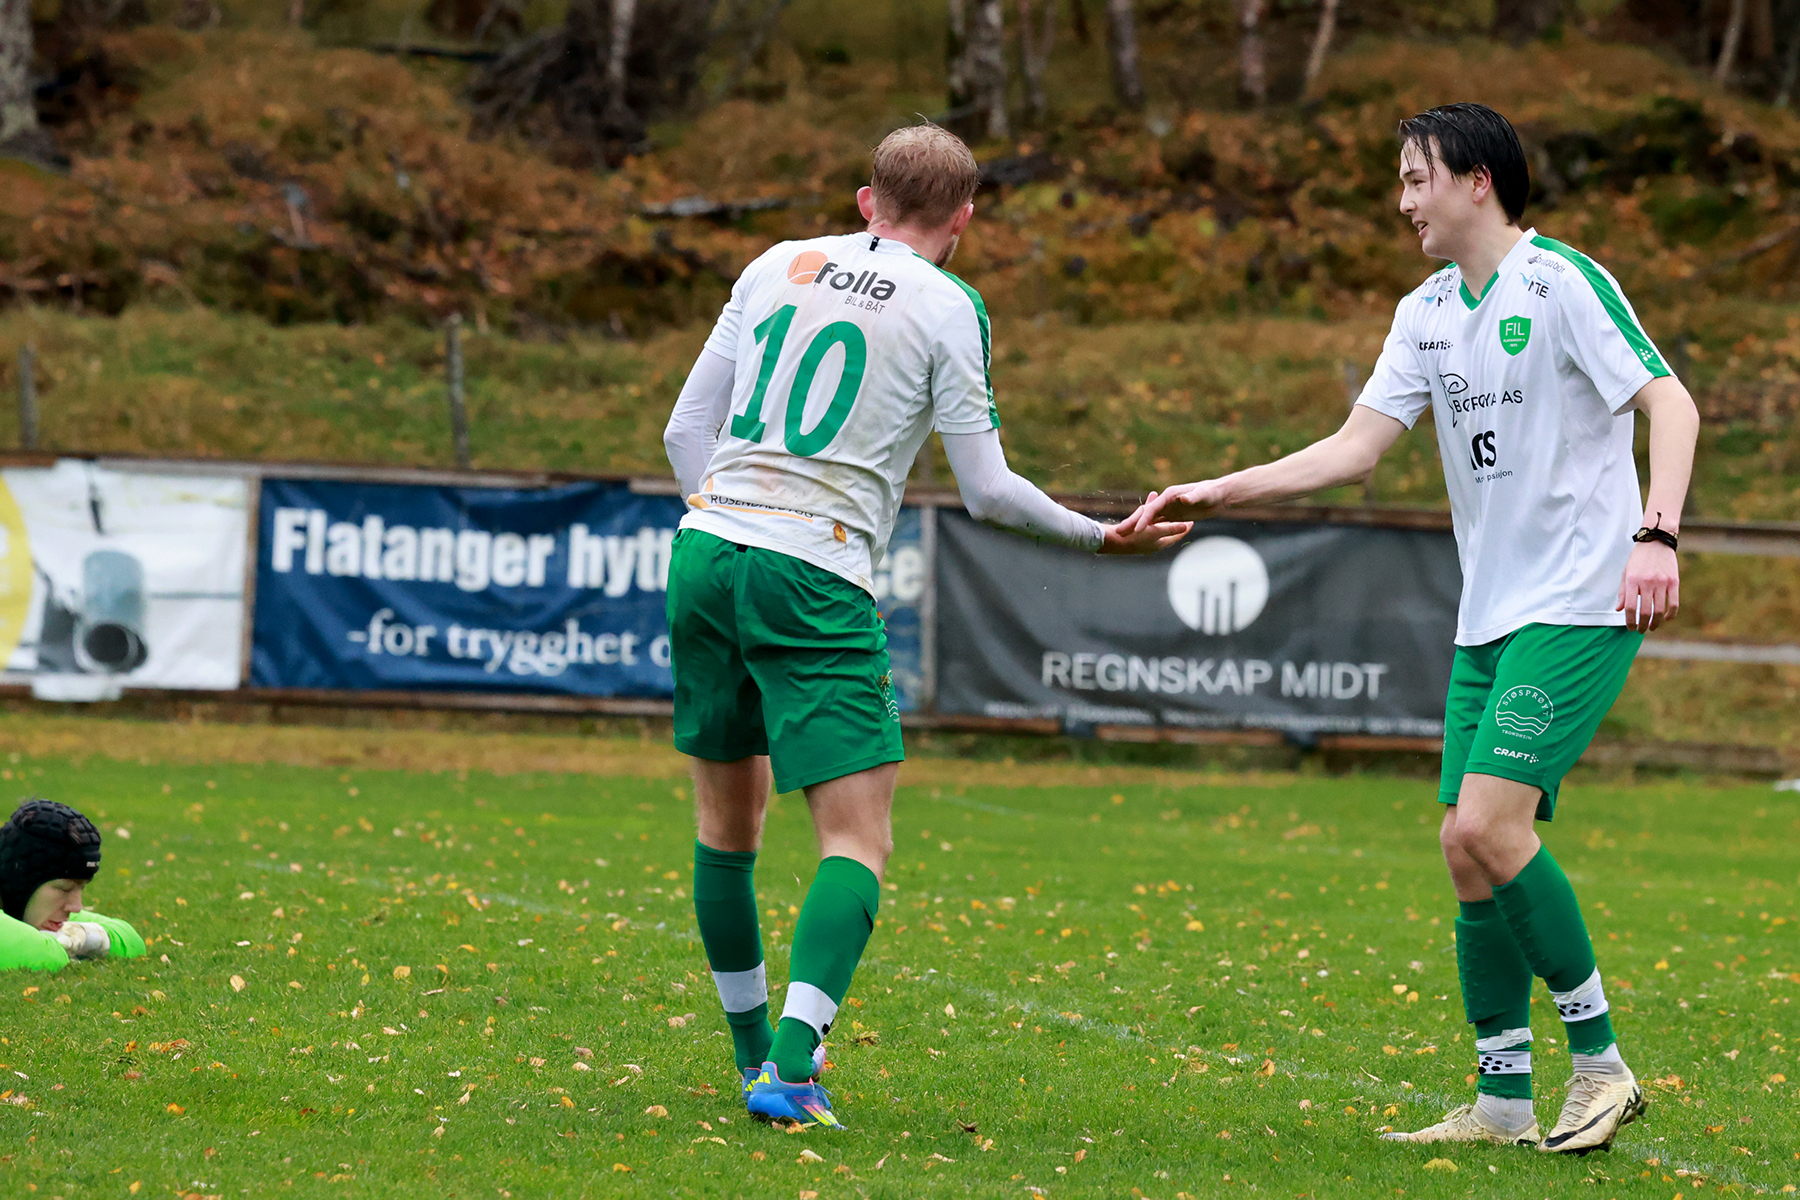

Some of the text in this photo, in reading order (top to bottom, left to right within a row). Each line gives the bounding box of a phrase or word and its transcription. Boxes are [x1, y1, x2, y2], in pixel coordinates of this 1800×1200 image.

[814, 262, 897, 301] folla
[844, 295, 857, 306] BIL
[864, 300, 886, 315] BÅT
[1505, 322, 1525, 336] FIL
[730, 303, 867, 458] 10
[1501, 390, 1523, 405] AS
[272, 506, 556, 592] Flatanger
[567, 523, 673, 597] hytt
[346, 607, 436, 656] -for
[446, 617, 640, 677] trygghet
[1041, 651, 1389, 700] REGNSKAP MIDT
[1502, 689, 1549, 716] SJØSPRØYT
[1501, 729, 1533, 741] TRONDHEIM
[1493, 747, 1530, 761] CRAFT
